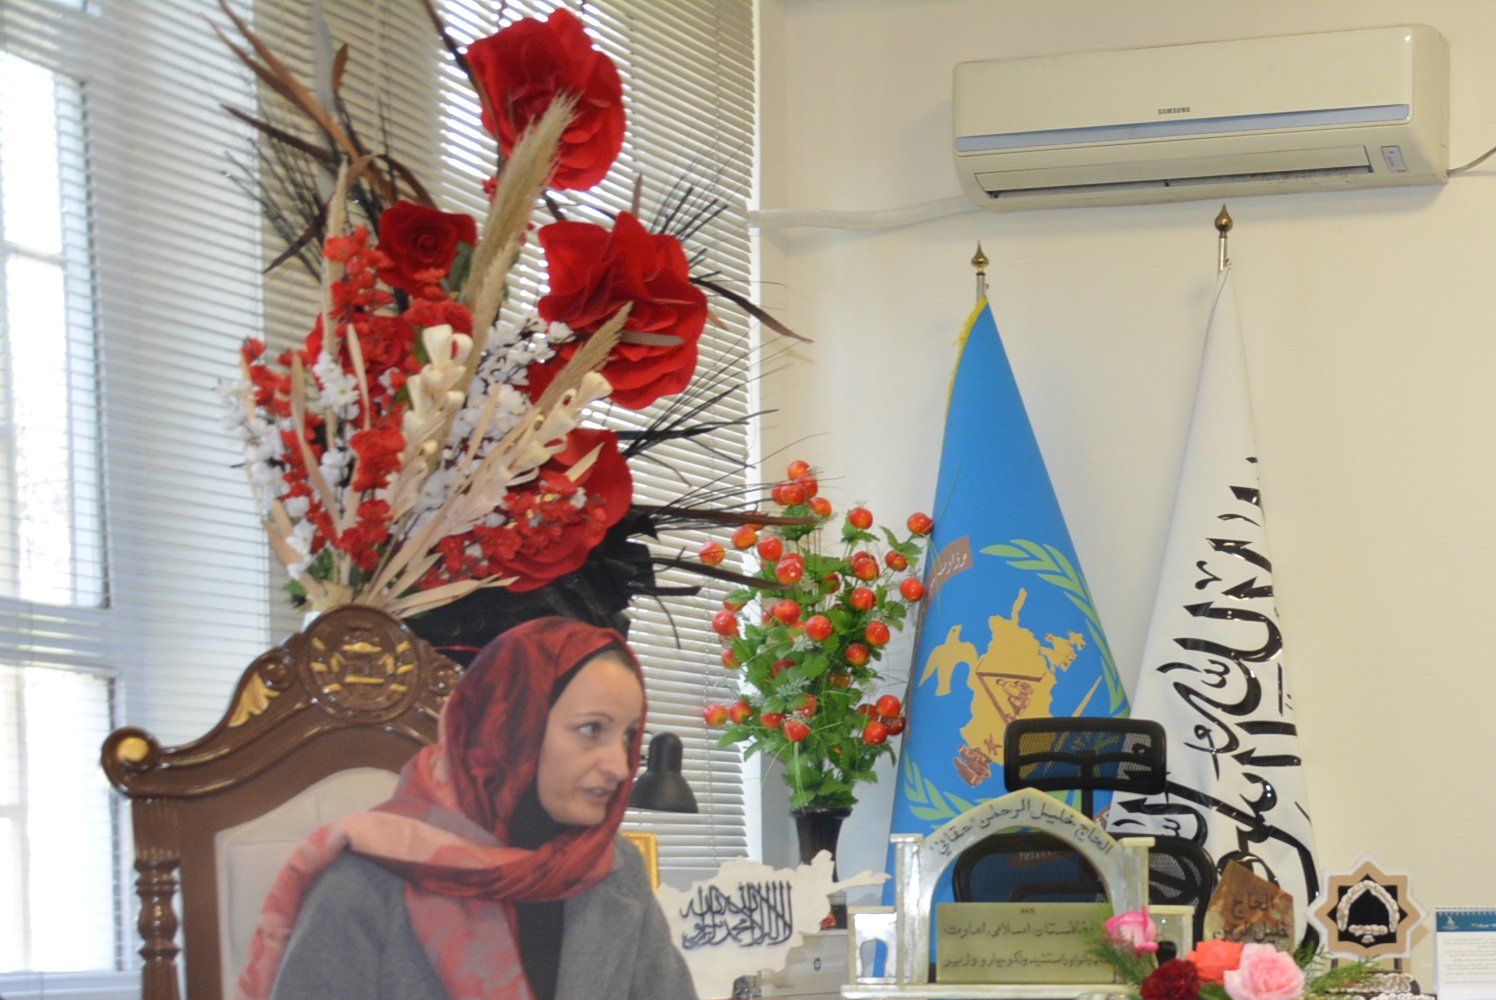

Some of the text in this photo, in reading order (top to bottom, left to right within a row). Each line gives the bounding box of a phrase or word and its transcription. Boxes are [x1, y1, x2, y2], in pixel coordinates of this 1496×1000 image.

[1157, 106, 1191, 115] SAMSUNG
[1075, 822, 1113, 855] الحاج
[1231, 892, 1275, 925] الحاج
